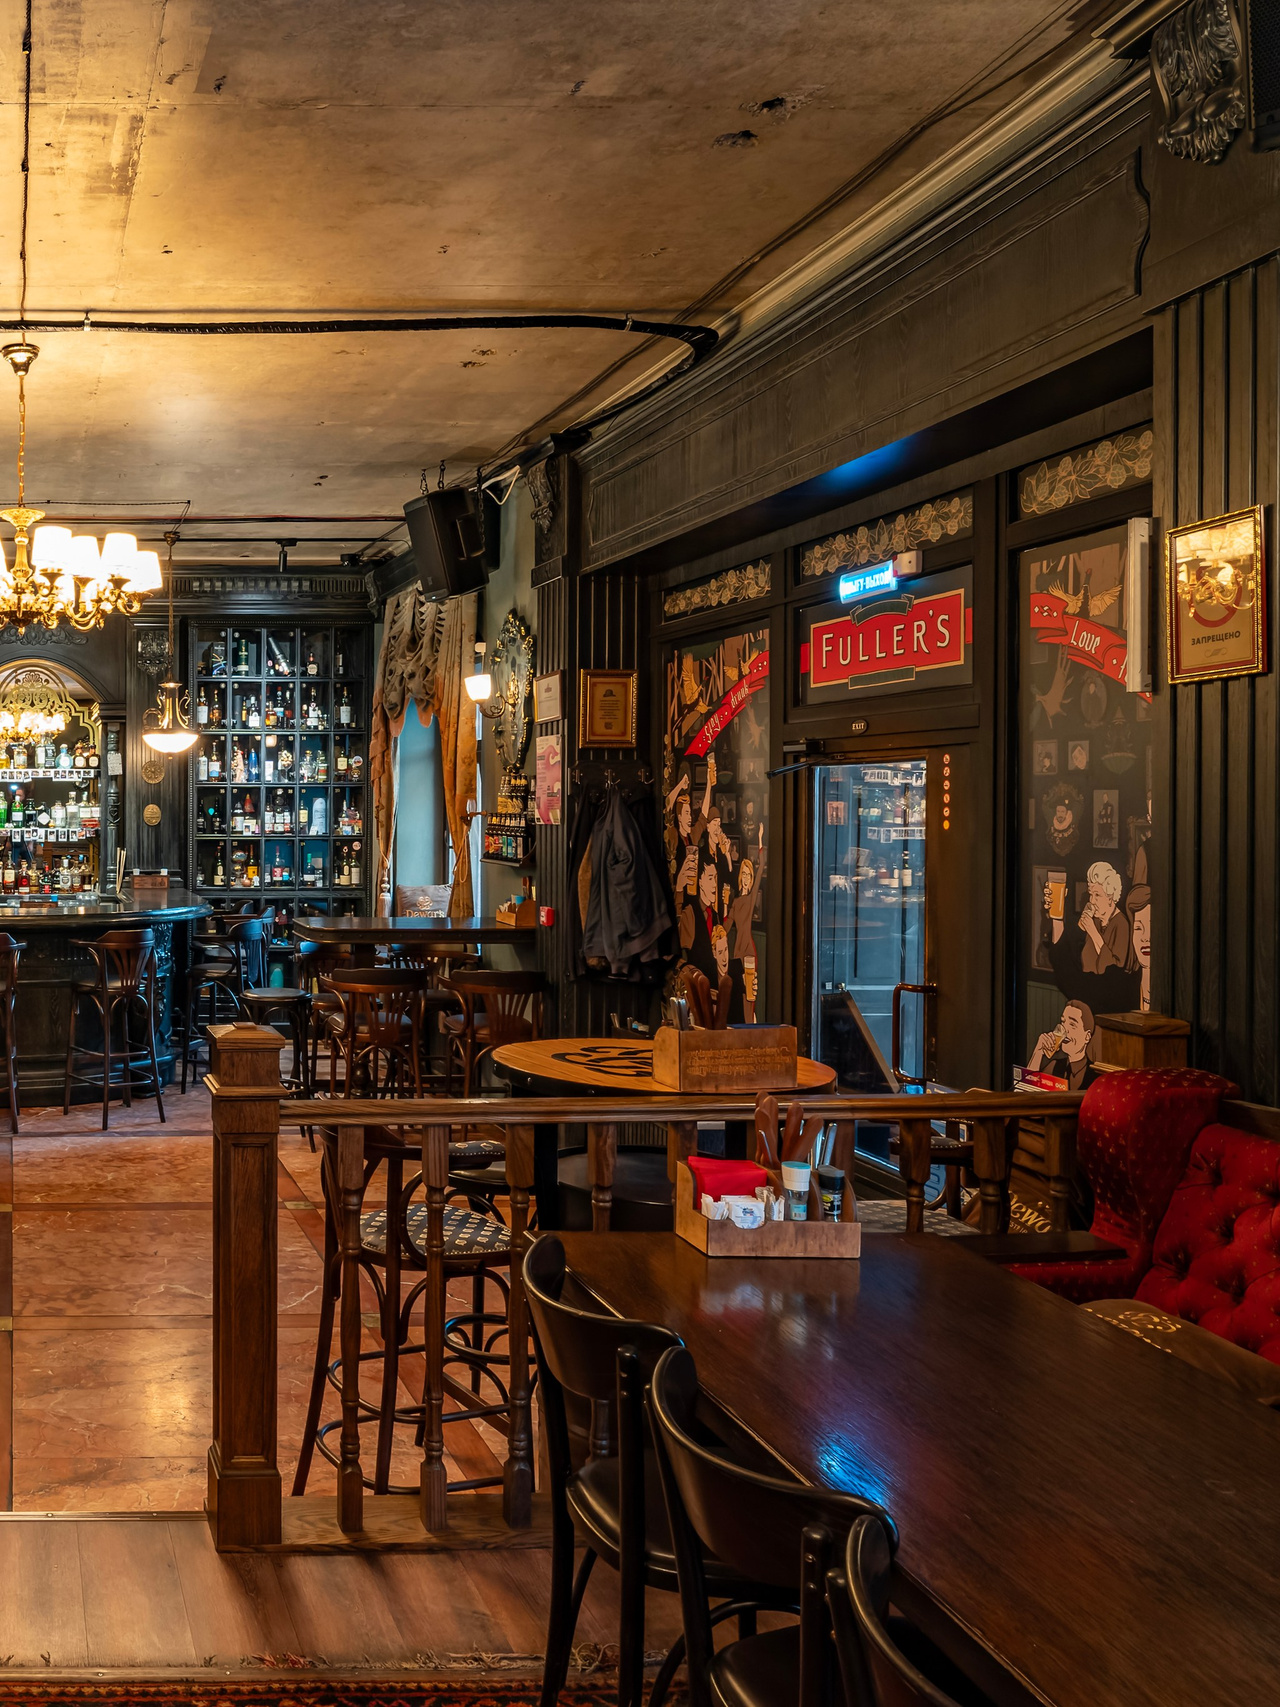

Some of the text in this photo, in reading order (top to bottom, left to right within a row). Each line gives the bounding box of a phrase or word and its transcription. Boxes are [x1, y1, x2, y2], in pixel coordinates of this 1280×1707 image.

[821, 609, 951, 668] FULLER'S
[1070, 620, 1101, 654] Love
[1190, 630, 1242, 647] ЗАПРЕЩЕНО
[852, 722, 865, 730] EXIT
